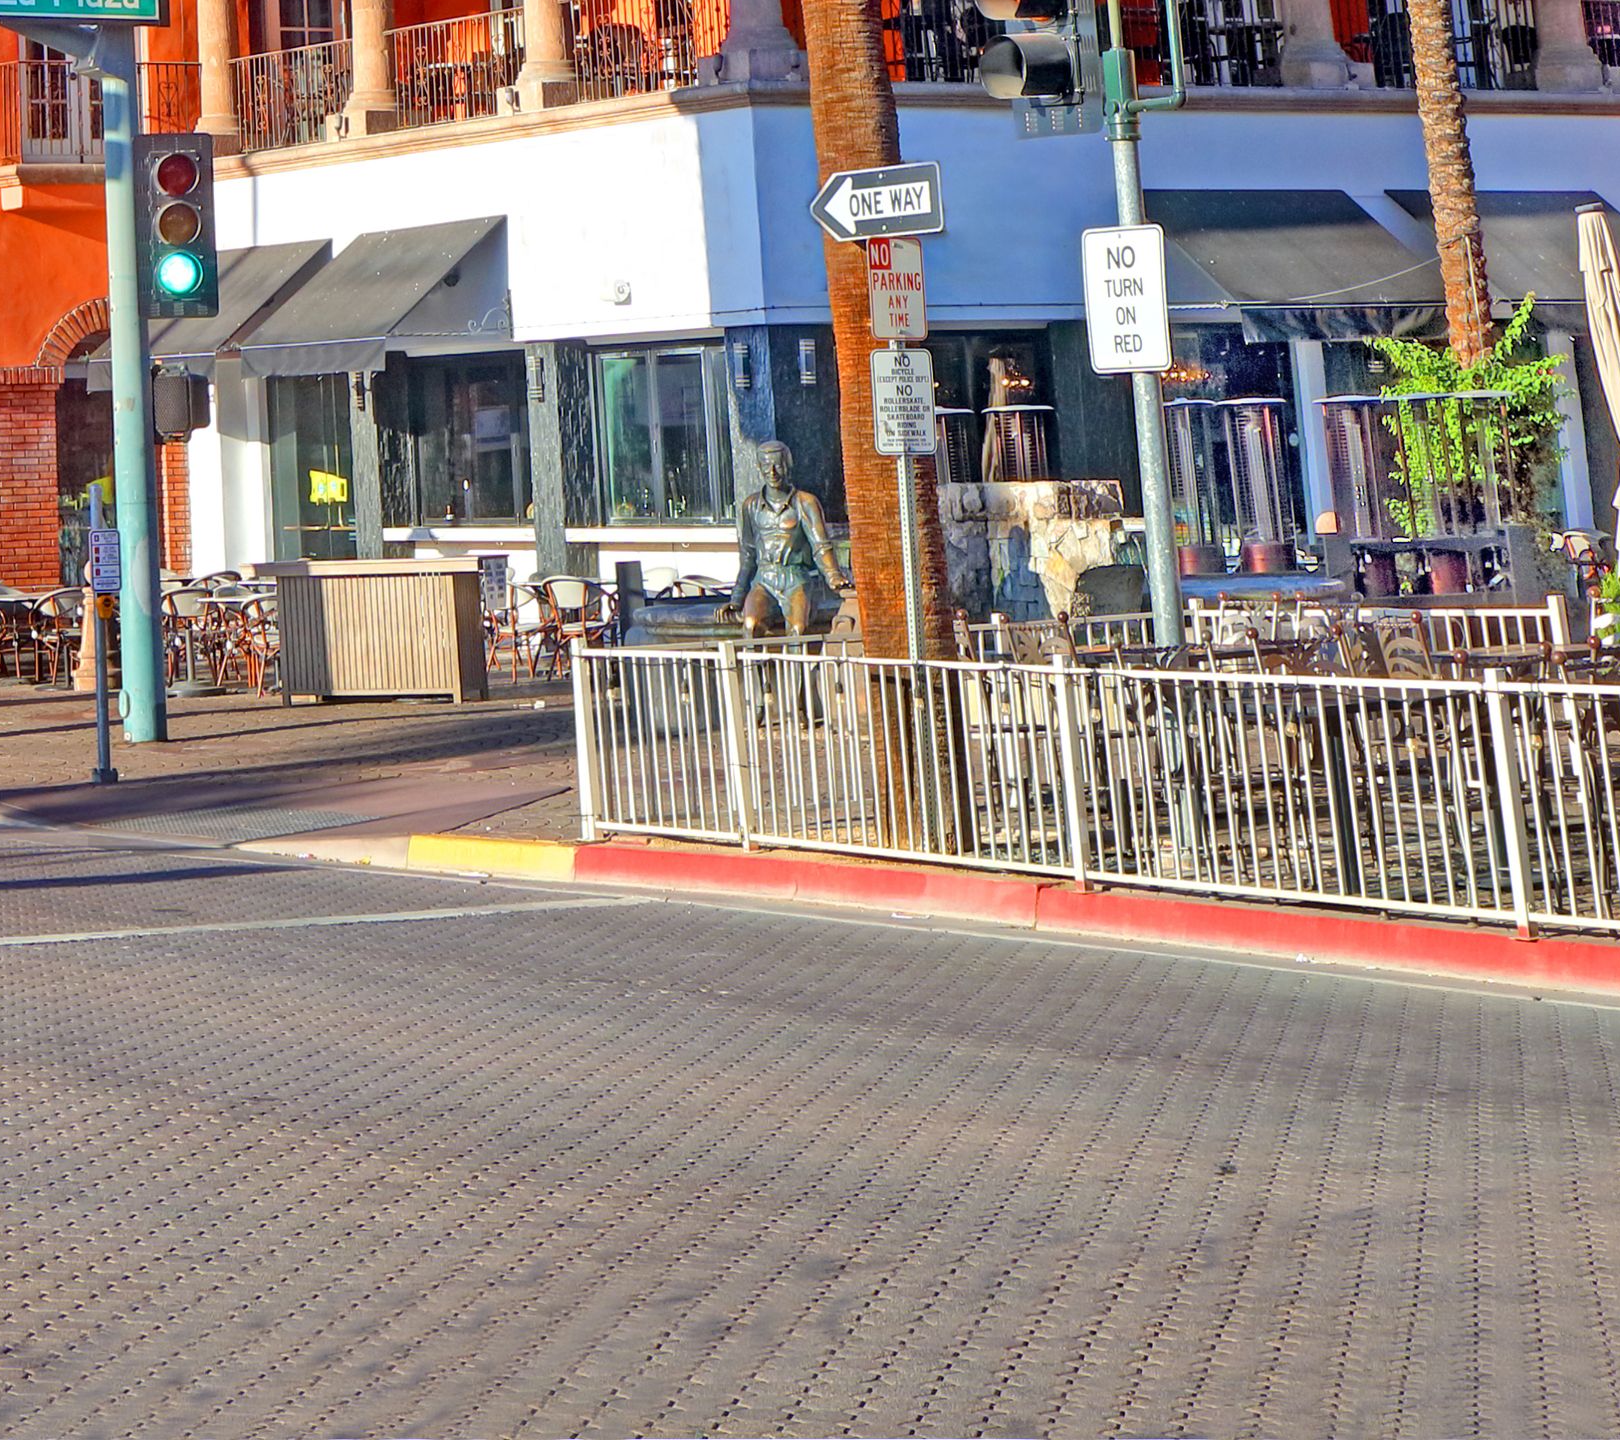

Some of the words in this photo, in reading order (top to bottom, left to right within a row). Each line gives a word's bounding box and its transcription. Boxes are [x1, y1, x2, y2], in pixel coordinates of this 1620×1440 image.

[849, 191, 884, 217] ONE
[889, 186, 924, 213] WAY
[870, 243, 889, 266] NO
[1107, 245, 1135, 270] NO
[872, 272, 921, 291] PARKING
[1104, 277, 1143, 298] TURN
[888, 295, 908, 309] ANY
[889, 313, 910, 327] TIME
[1116, 306, 1136, 325] ON
[1114, 334, 1143, 353] RED
[894, 355, 910, 367] NO
[896, 384, 913, 397] NO
